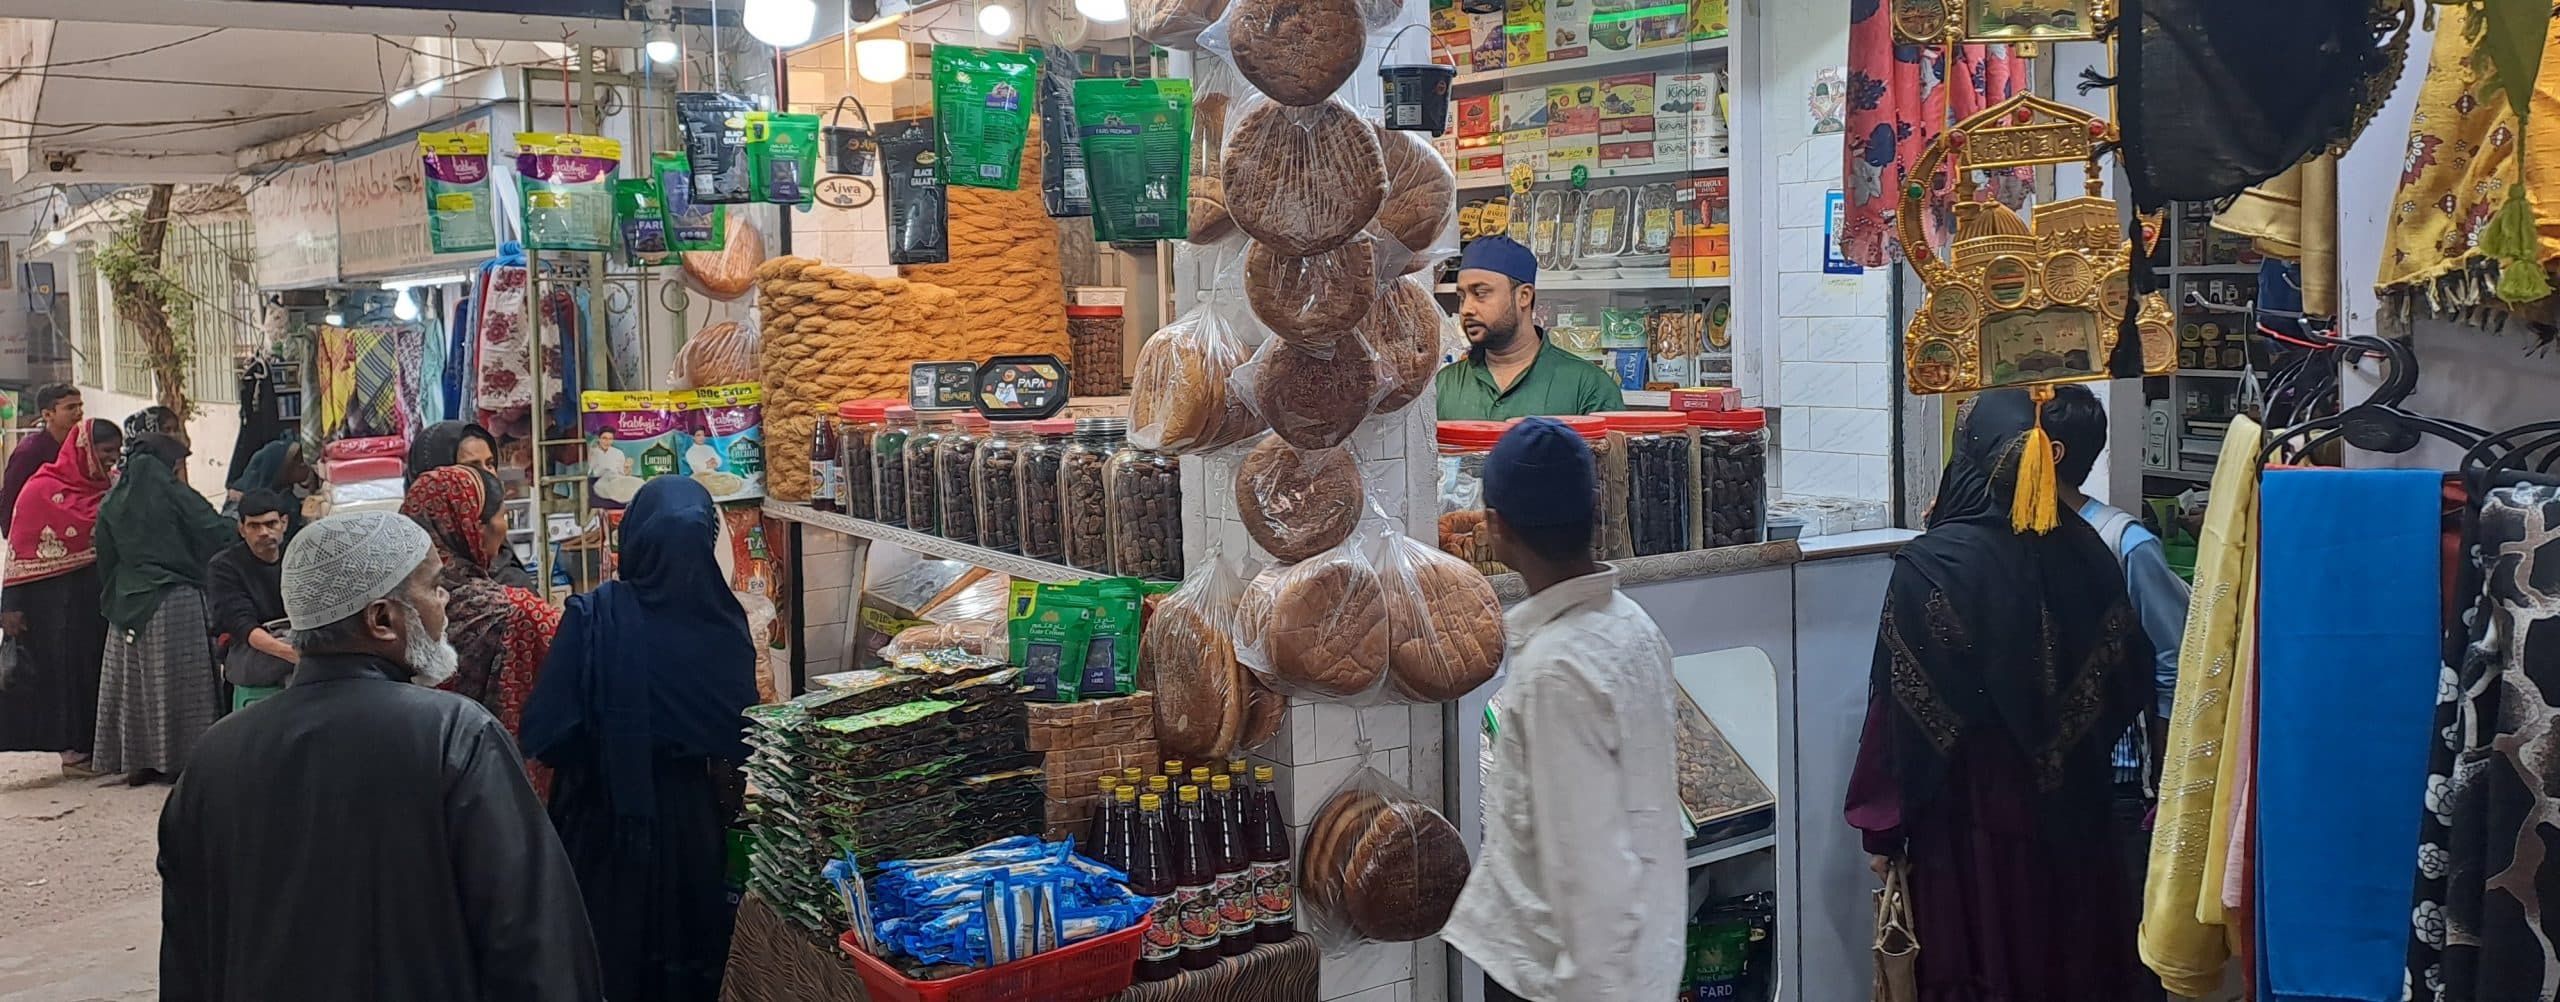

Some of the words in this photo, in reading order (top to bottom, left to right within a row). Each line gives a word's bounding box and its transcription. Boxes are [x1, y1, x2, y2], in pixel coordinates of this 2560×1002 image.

[824, 181, 861, 196] Ajwa
[1625, 351, 1638, 380] TASTY
[1017, 378, 1046, 388] PAPA
[1700, 985, 1733, 998] FARD
